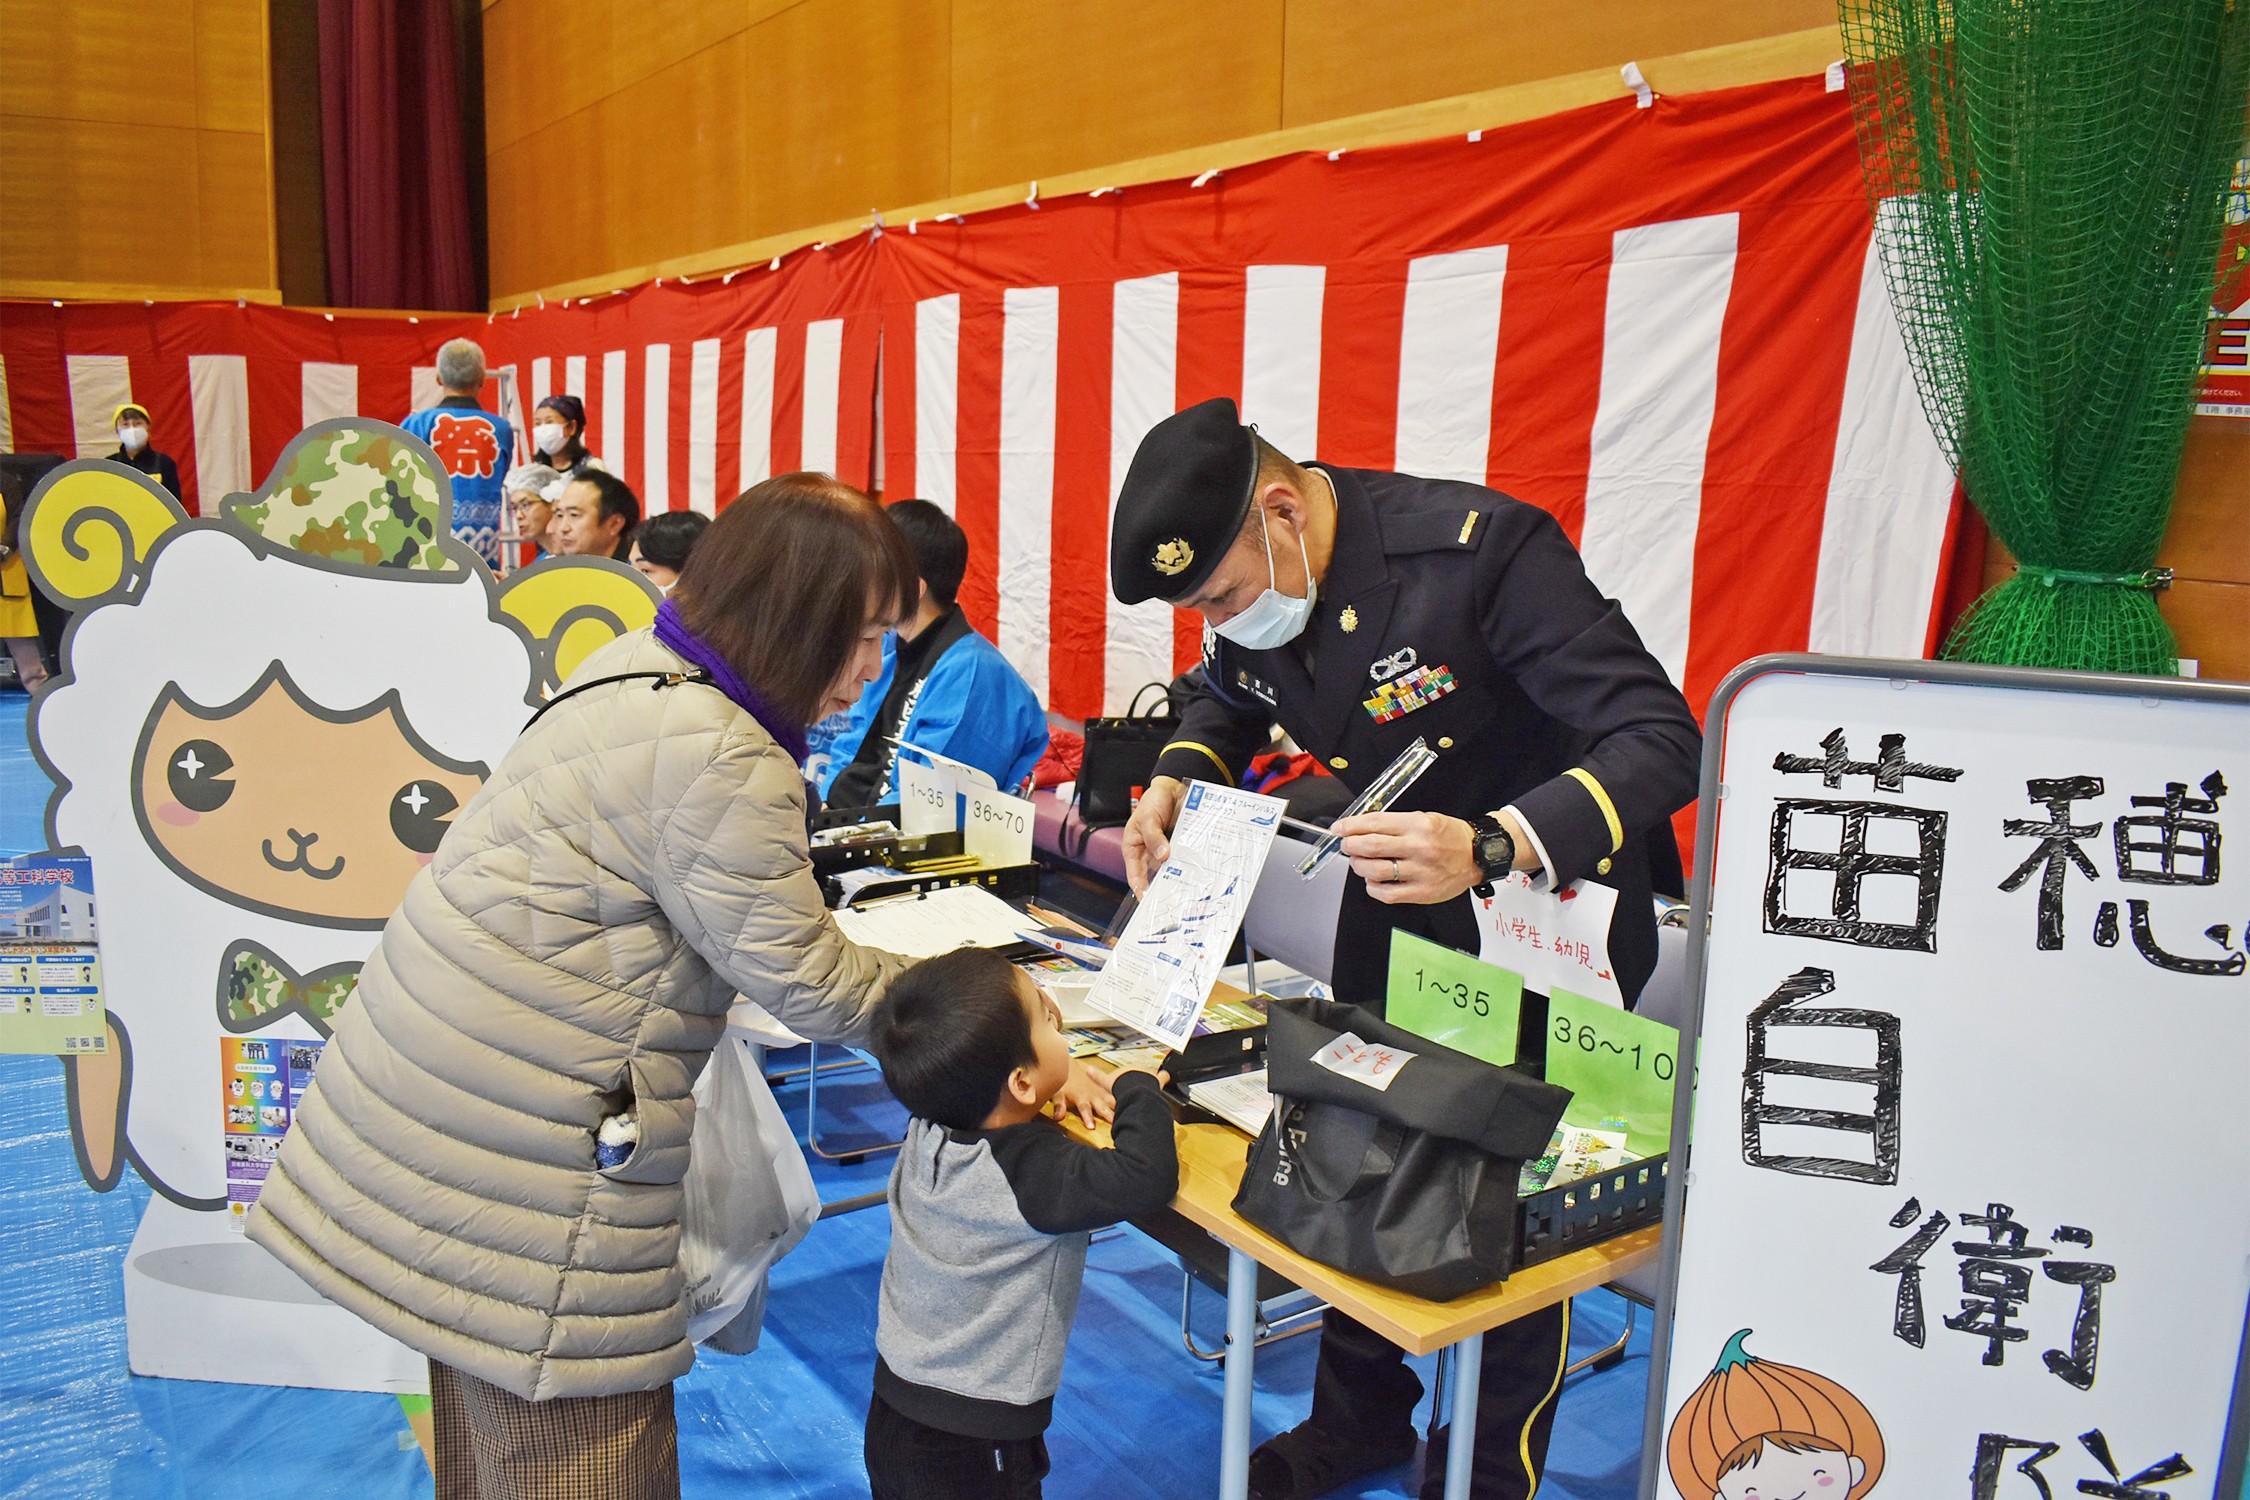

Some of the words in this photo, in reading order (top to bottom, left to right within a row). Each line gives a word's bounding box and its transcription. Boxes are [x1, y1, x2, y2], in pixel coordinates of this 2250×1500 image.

[431, 413, 499, 479] 祭
[973, 800, 1025, 834] 36~70
[1762, 727, 2247, 976] 苗穂
[1332, 1043, 1394, 1076] こども
[1554, 1016, 1699, 1091] 36~10
